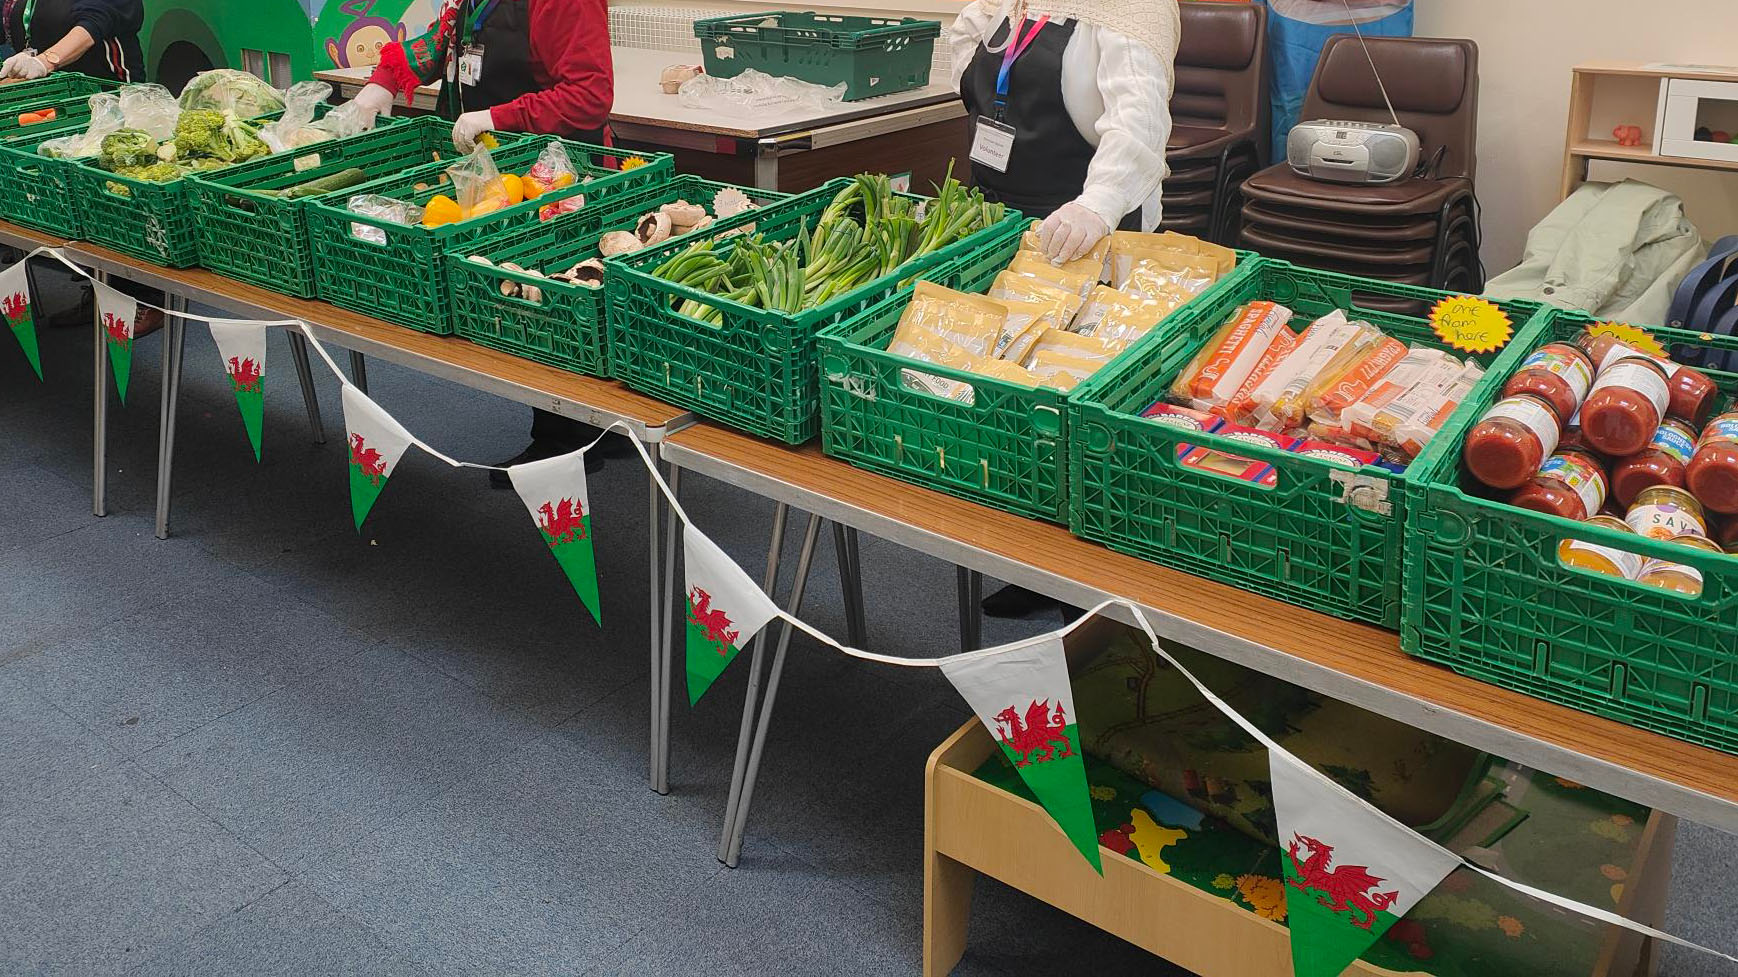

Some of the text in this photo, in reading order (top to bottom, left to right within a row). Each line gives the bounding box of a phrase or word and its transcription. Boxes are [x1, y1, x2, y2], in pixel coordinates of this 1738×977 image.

[979, 143, 1005, 159] Volunteer
[1440, 313, 1476, 328] from
[1218, 308, 1264, 354] SPAGHETTI
[1456, 330, 1488, 342] here
[1360, 342, 1401, 380] SPAGHETTI
[931, 375, 949, 389] FOOD
